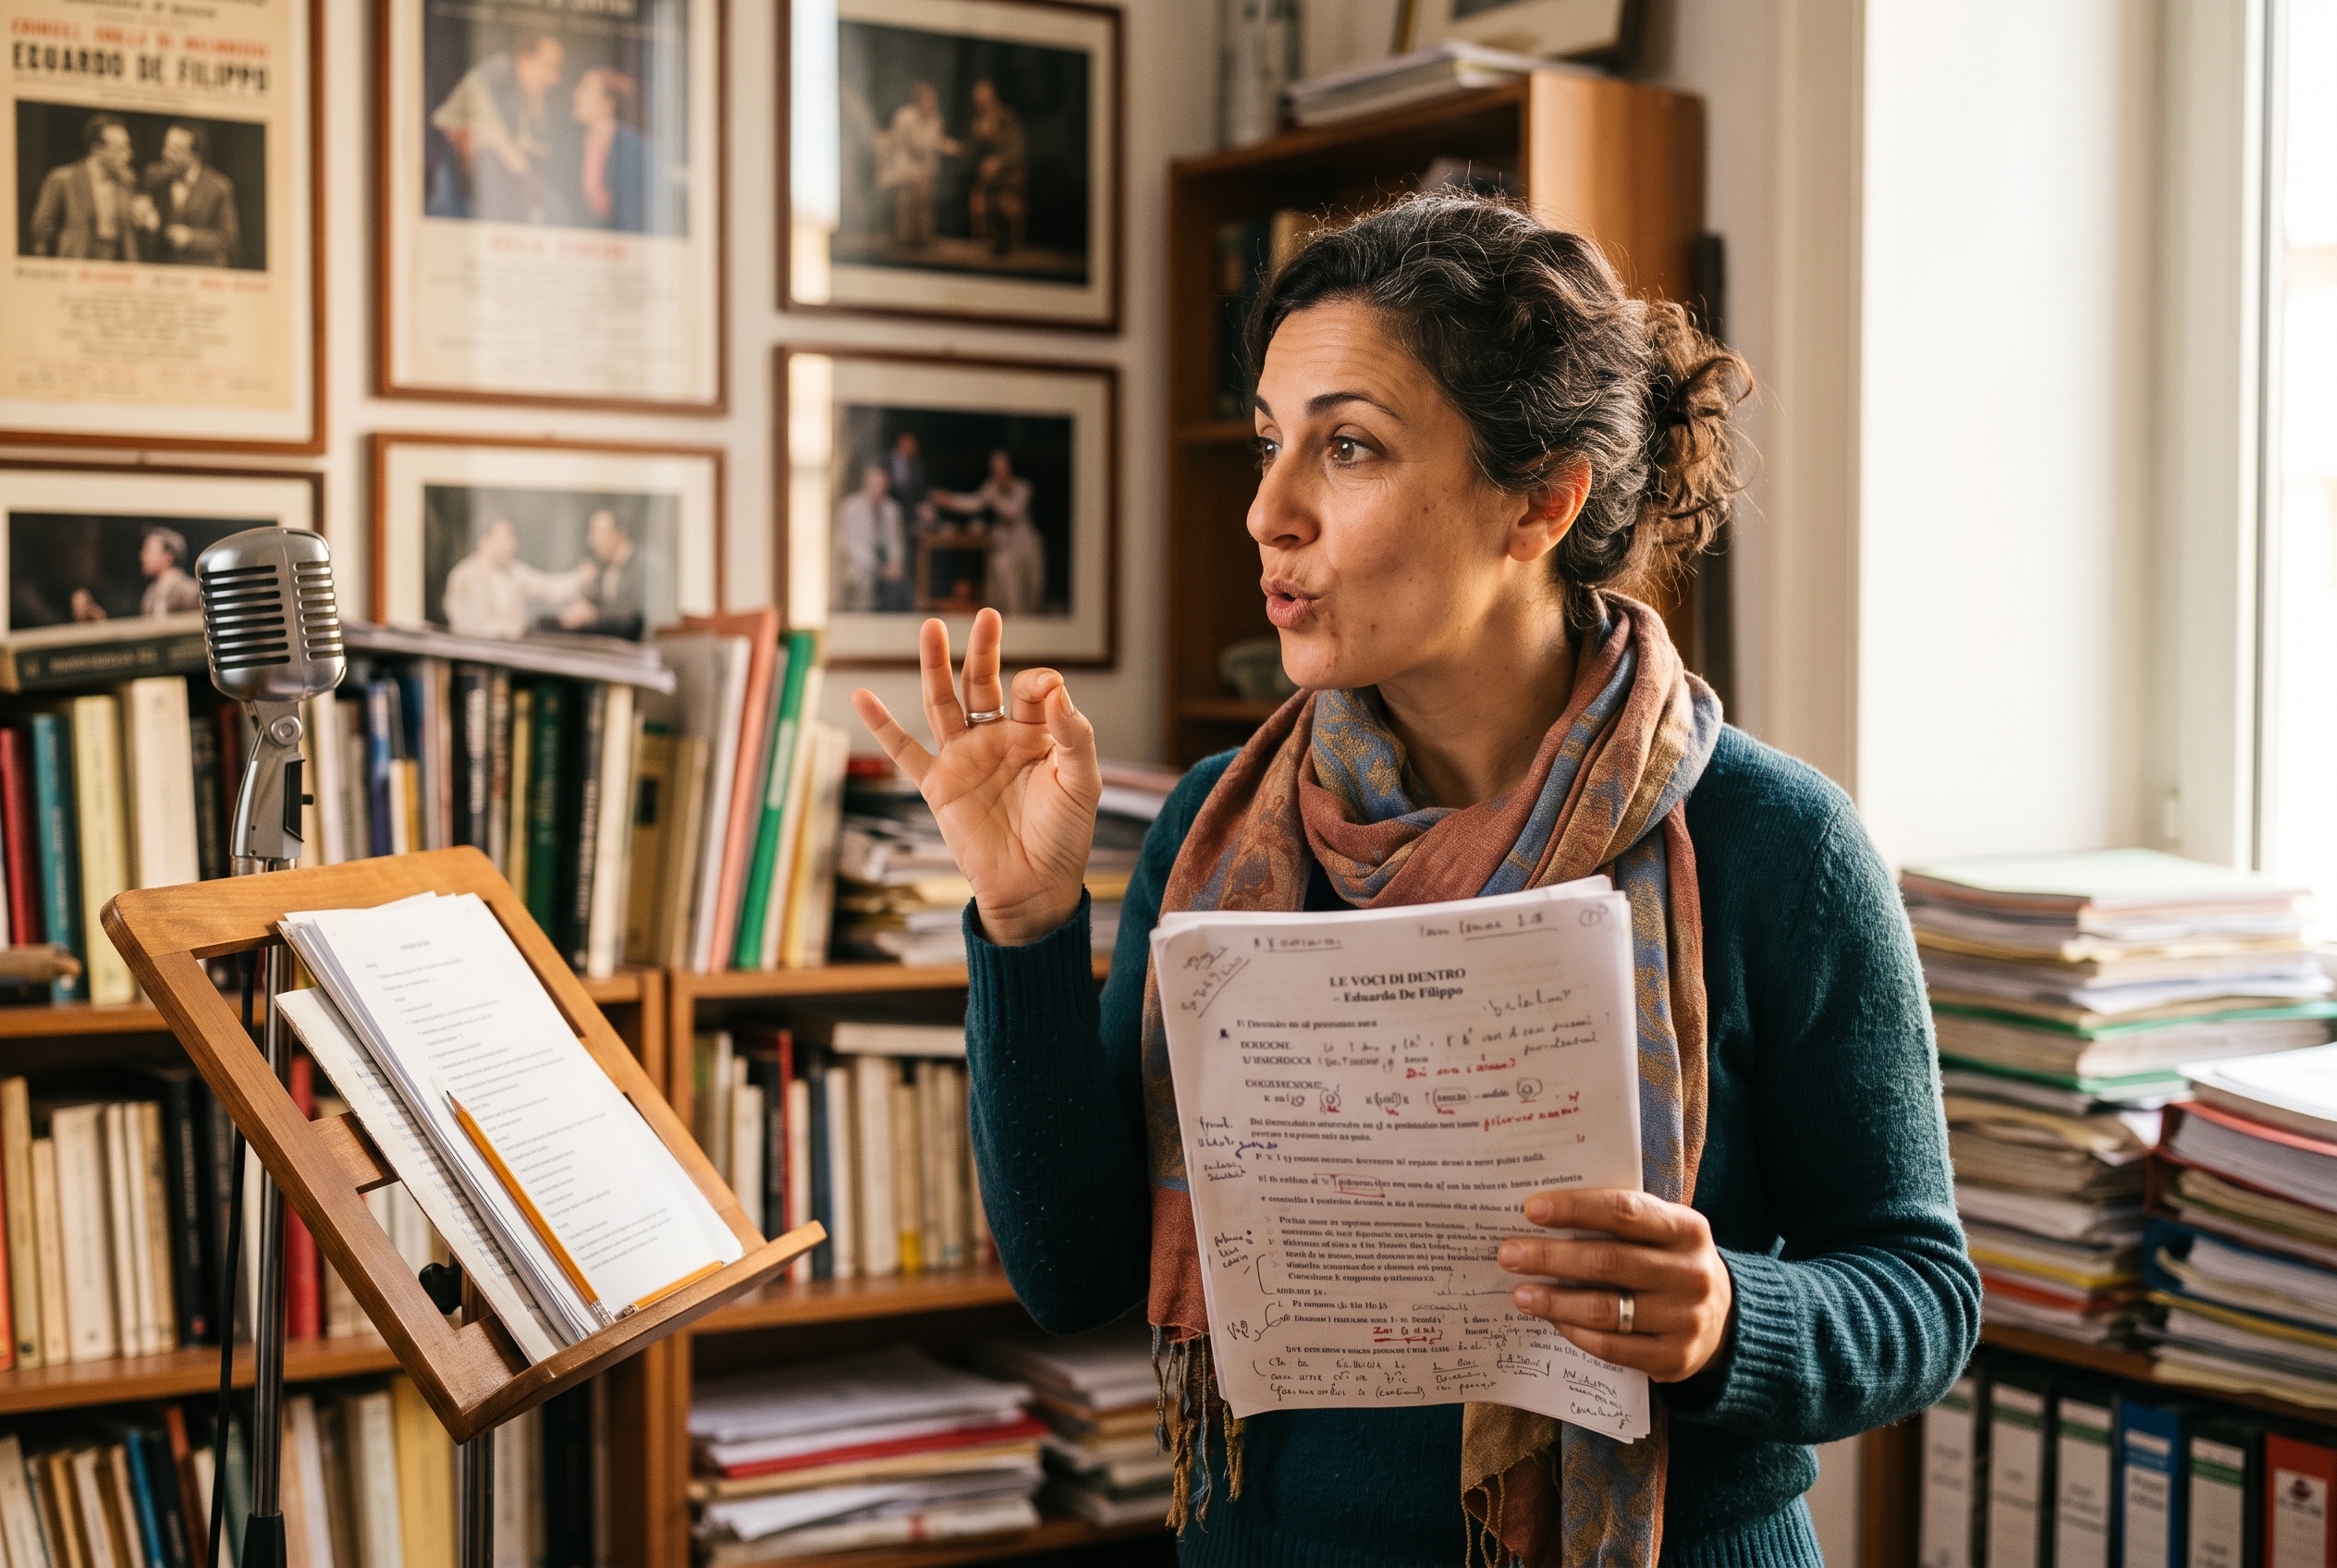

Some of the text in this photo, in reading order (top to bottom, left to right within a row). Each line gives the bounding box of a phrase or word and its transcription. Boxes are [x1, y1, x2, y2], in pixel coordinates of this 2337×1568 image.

[1329, 967, 1466, 987] LE VOCI DI DENTRO
[1400, 989, 1416, 1000] De
[1419, 986, 1463, 999] Filippo
